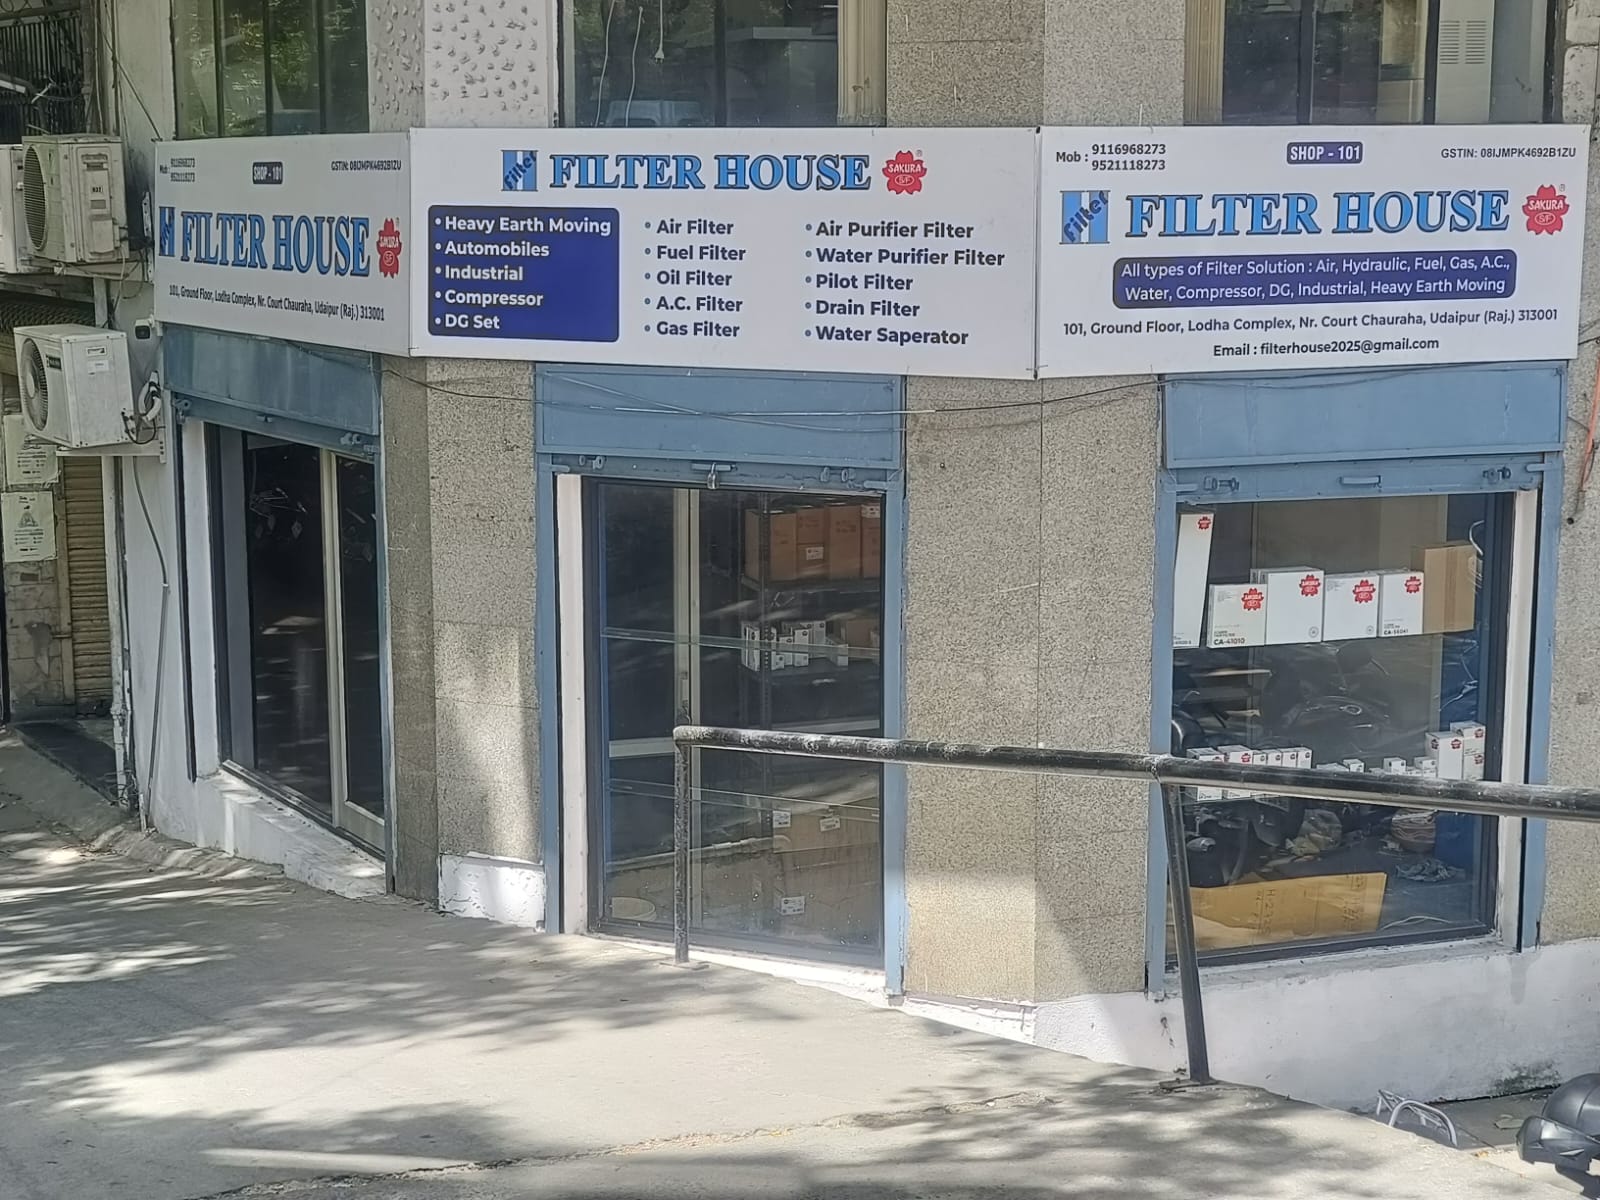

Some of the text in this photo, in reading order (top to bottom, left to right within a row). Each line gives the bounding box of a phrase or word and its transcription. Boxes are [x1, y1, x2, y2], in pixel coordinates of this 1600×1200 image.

[1092, 144, 1166, 155] 9116968273
[1290, 146, 1324, 160] SHOP
[1338, 146, 1360, 160] 101
[1440, 147, 1576, 158] GSTIN: 08IJMPK4692B1ZU
[549, 154, 871, 190] FILTER HOUSE
[888, 163, 921, 174] SAKURA
[1092, 160, 1166, 171] 9521118273
[1528, 199, 1564, 210] SAKURA
[1125, 190, 1510, 237] FILTER HOUSE
[445, 216, 612, 237] Heavy Earth Moving
[657, 220, 734, 236] Air Filter
[816, 220, 974, 238] Air Purifier Filter
[181, 211, 268, 270] FILTER
[272, 215, 370, 278] HOUSE
[445, 241, 550, 257] Automobiles
[657, 245, 746, 261] Fuel Filter
[816, 248, 1005, 266] Water Purifier Filter
[445, 265, 524, 281] Industrial
[1121, 263, 1140, 278] All
[1144, 262, 1184, 280] types
[1188, 262, 1204, 276] of
[1206, 261, 1244, 276] Filter
[1246, 260, 1304, 274] Solution
[1316, 258, 1338, 274] Air,
[1342, 256, 1410, 275] Hydraulic,
[1414, 256, 1446, 272] Fuel,
[1450, 256, 1477, 271] Gas,
[1480, 256, 1510, 270] A.C.,
[657, 270, 732, 286] Oil Filter
[816, 273, 914, 290] Pilot Filter
[1126, 278, 1505, 302] Water, Compressor, DG, Industrial, Heavy Earth Moving
[445, 290, 544, 308] Compressor
[657, 296, 743, 312] A.C. Filter
[360, 306, 384, 321] 313001
[816, 299, 920, 317] Drain Filter
[445, 314, 500, 330] DG Set
[657, 321, 740, 338] Gas Filter
[1064, 309, 1558, 336] 101, Ground Floor, Lodha Complex, Nr. Court Chauraha, Udaipur (Raj.) 313001
[816, 326, 968, 346] Water Saperator
[1213, 344, 1250, 356] Email
[1260, 338, 1440, 355] filterhouse2025@gmail.com
